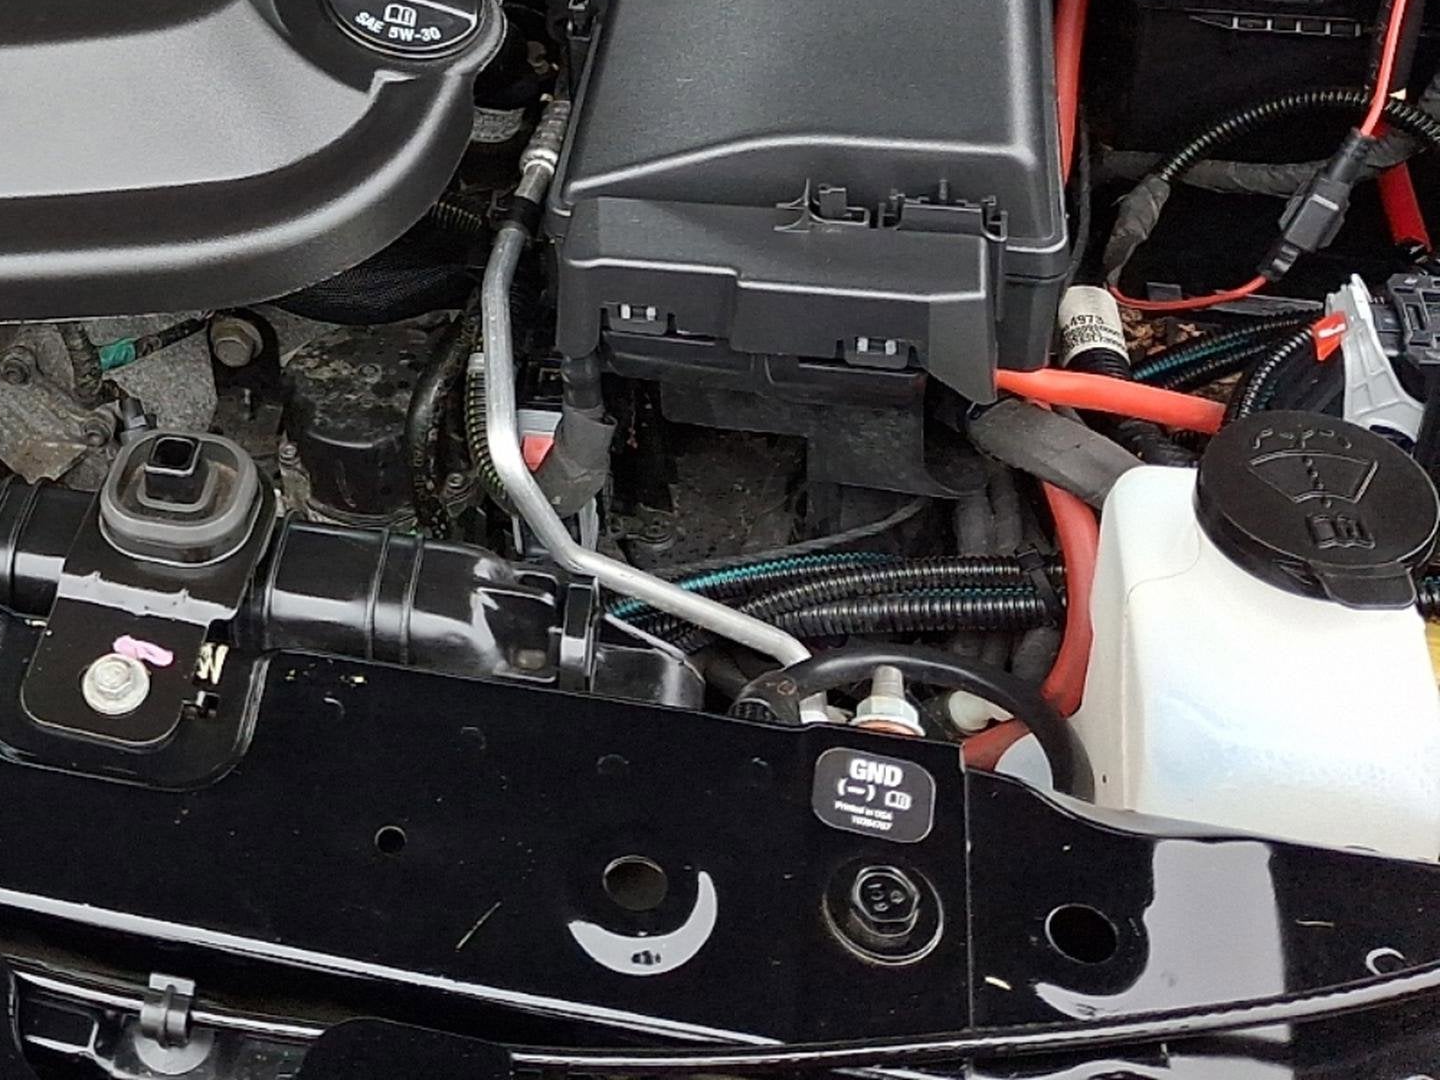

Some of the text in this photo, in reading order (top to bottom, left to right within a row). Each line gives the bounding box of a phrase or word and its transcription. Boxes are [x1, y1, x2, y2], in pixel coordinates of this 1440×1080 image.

[355, 12, 442, 42] SAE 5W-30
[849, 758, 903, 787] GND
